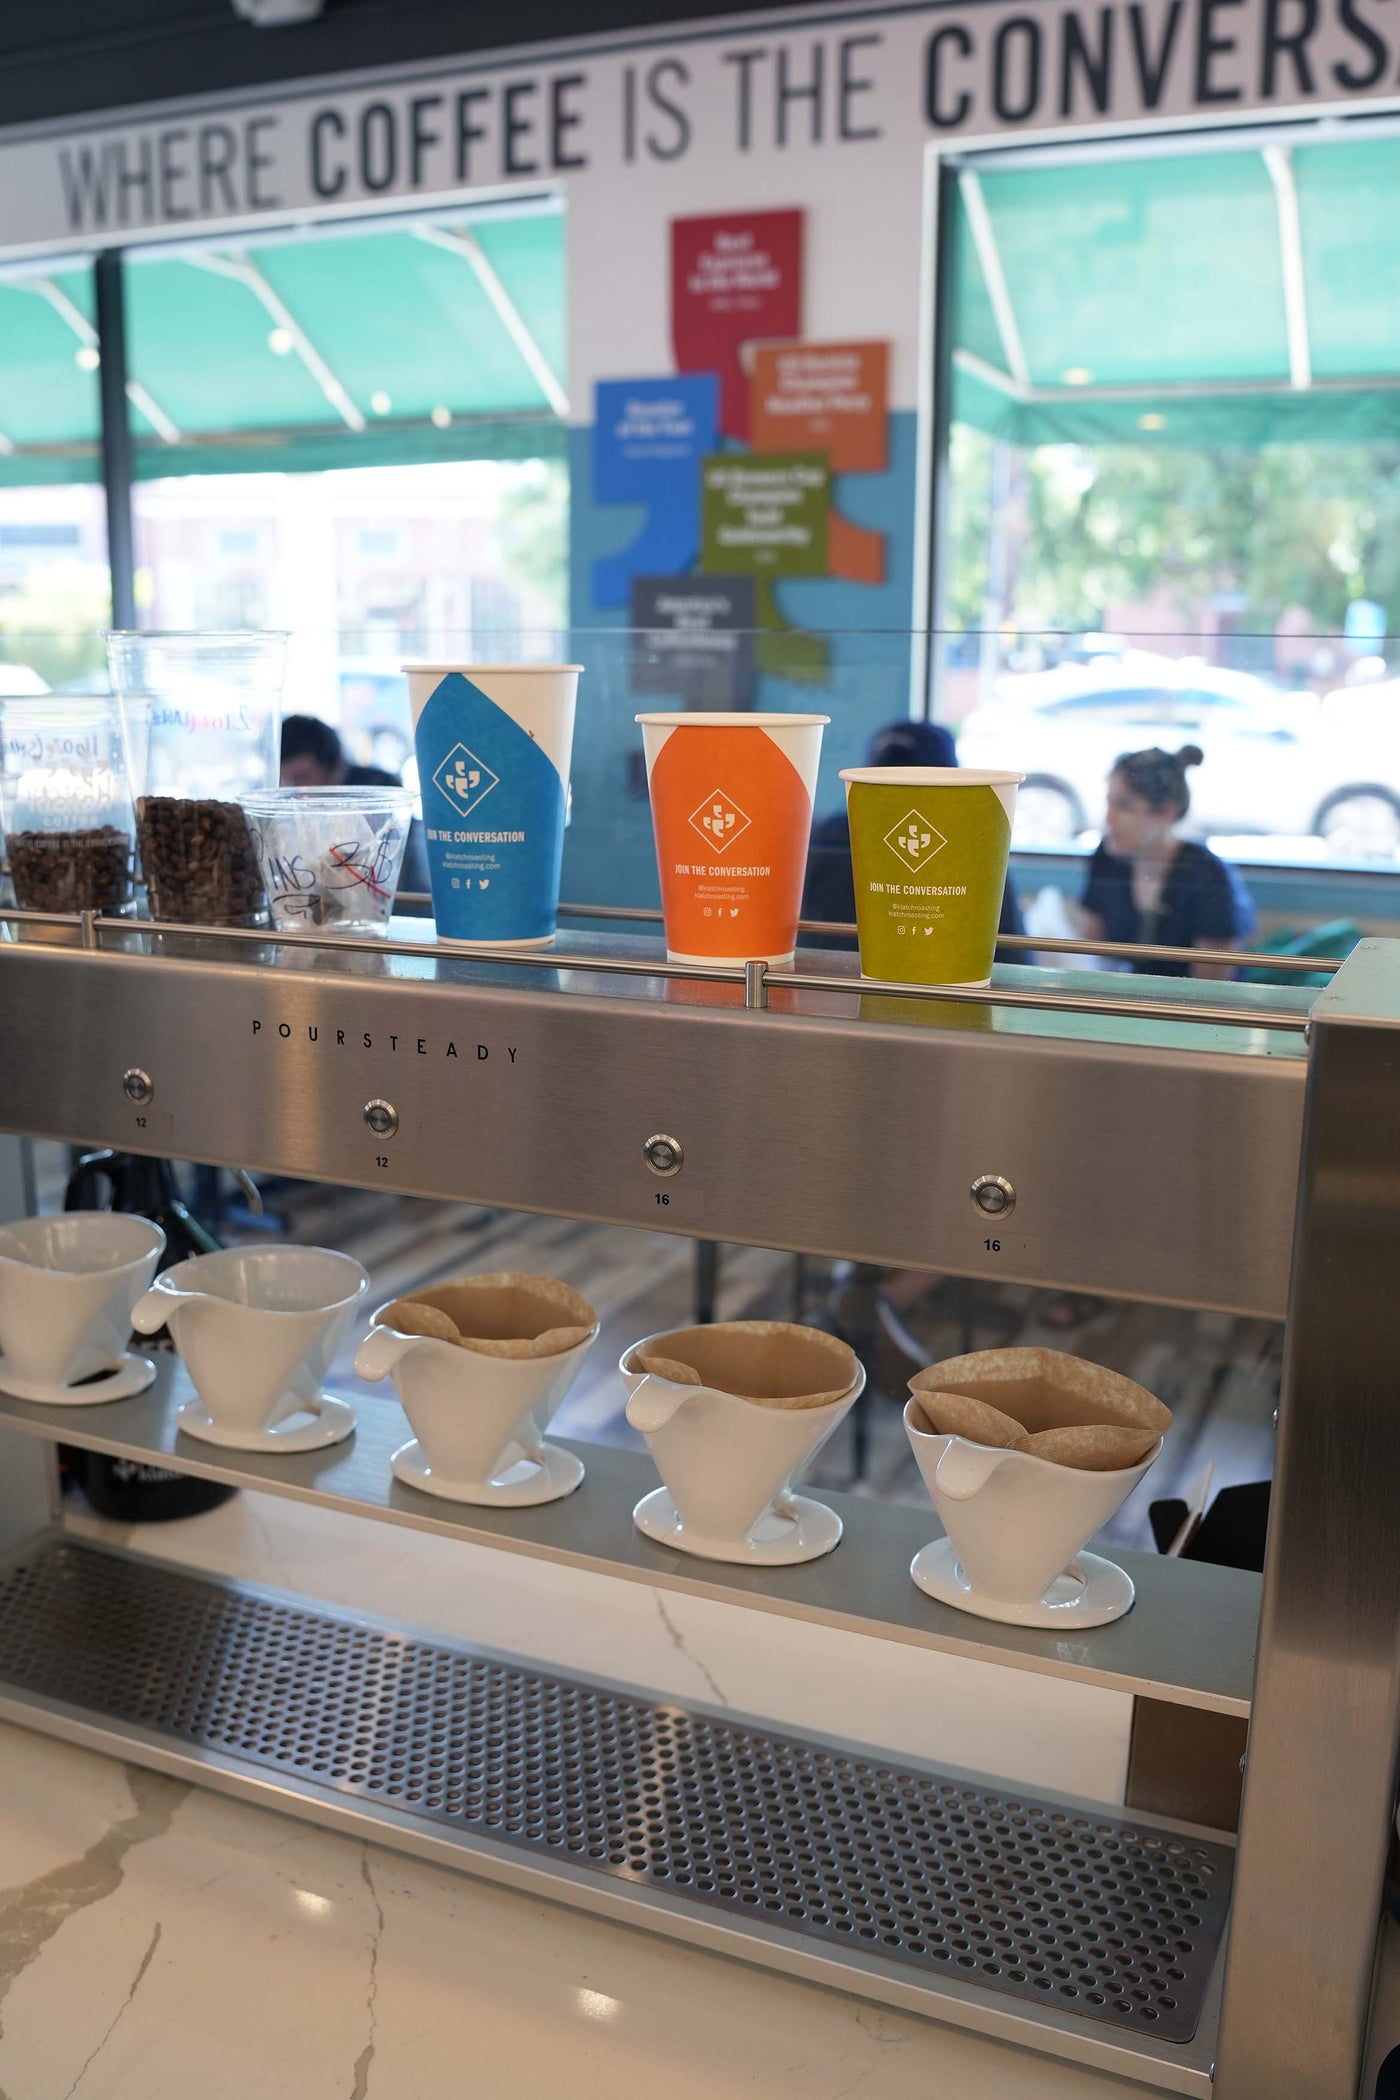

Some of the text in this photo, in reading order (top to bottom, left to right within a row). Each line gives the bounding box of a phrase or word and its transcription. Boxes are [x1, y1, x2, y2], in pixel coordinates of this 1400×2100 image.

[58, 0, 1400, 231] WHERE COFFEE IS THE CONVERS
[438, 830, 452, 842] THE
[454, 831, 525, 843] CONVERSATION
[675, 864, 771, 877] JOIN THE CONVERSATION
[869, 882, 967, 896] JOIN THE CONVERSATION
[888, 911, 945, 920] klatchroasting.com
[252, 1020, 517, 1064] POURSTEADY
[136, 1117, 147, 1128] 12
[375, 1156, 388, 1168] 12
[654, 1193, 670, 1205] 16
[983, 1239, 1001, 1252] 16
